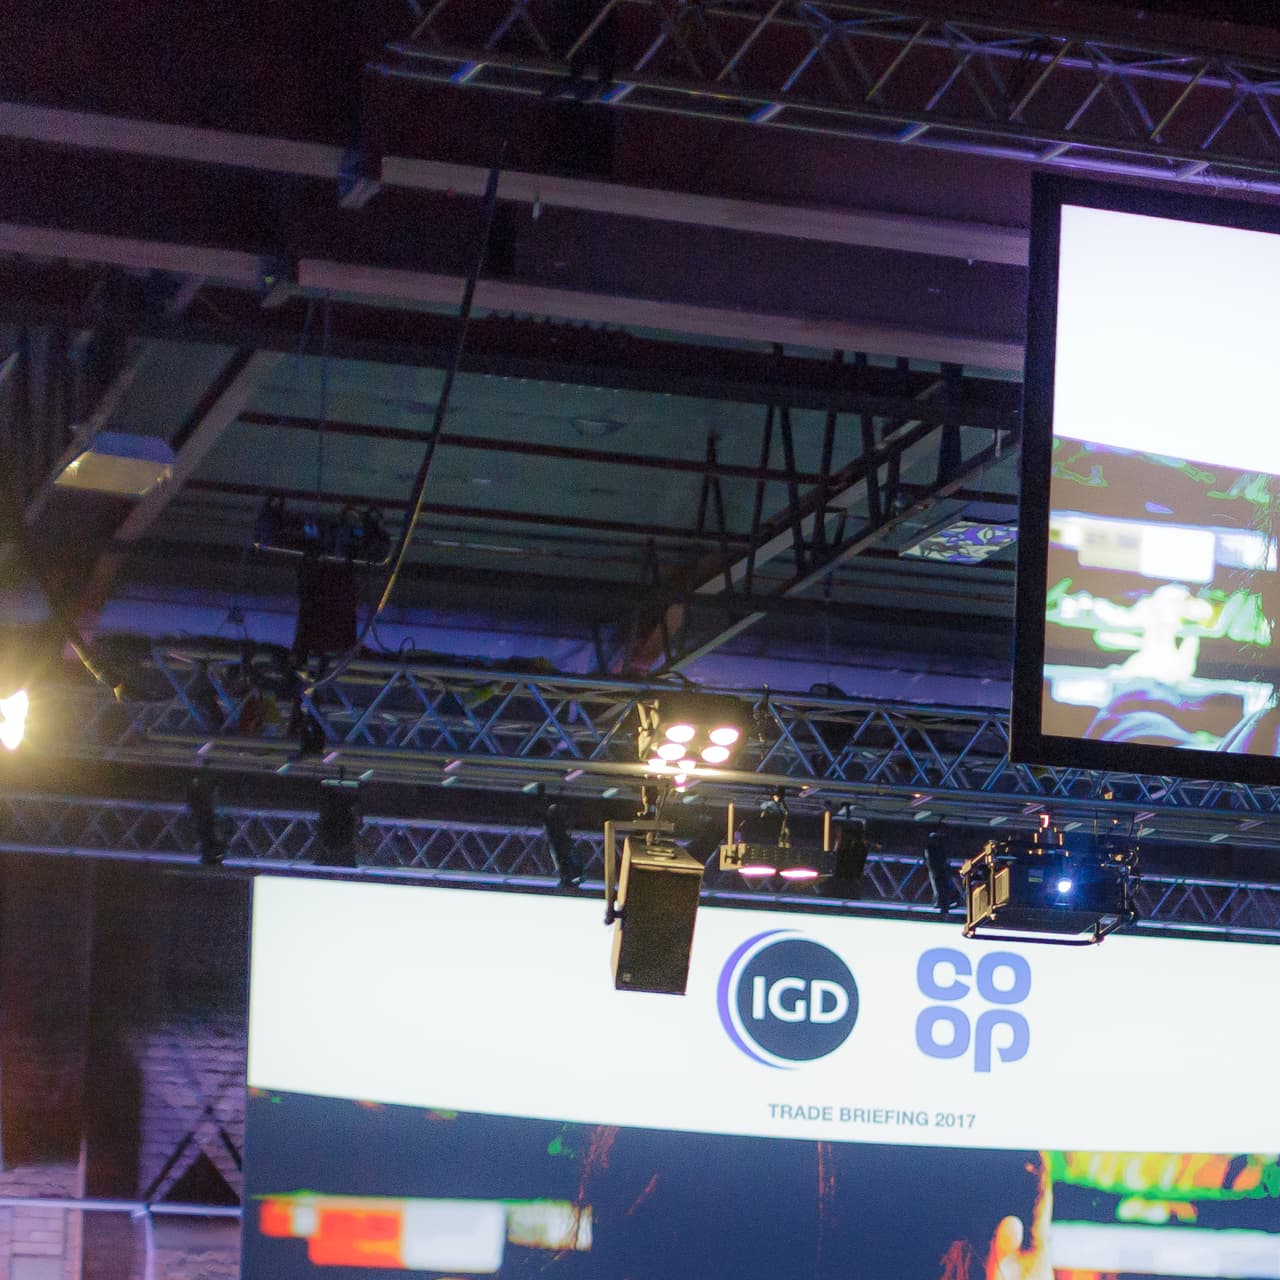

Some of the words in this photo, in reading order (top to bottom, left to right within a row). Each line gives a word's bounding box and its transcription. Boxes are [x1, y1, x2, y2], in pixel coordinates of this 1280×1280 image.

[752, 975, 849, 1023] IGD
[768, 1103, 833, 1121] TRADE
[840, 1107, 929, 1127] BRIEFING
[934, 1112, 976, 1129] 2017
